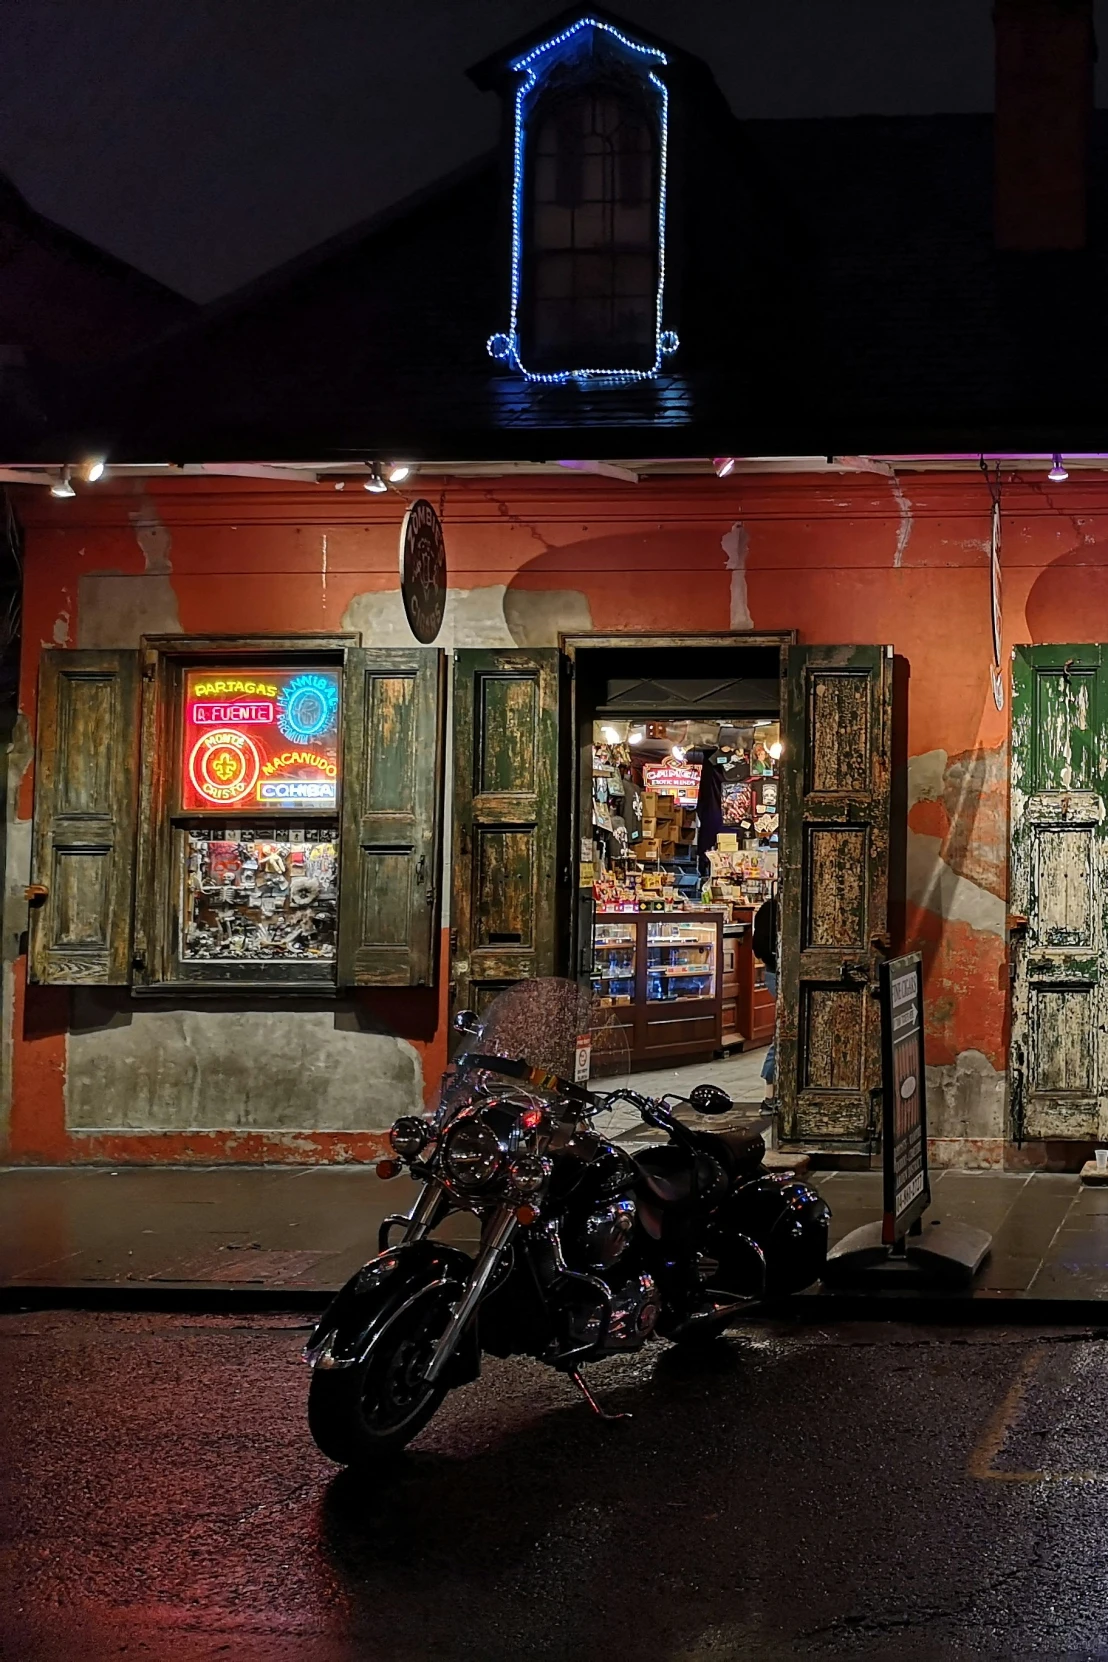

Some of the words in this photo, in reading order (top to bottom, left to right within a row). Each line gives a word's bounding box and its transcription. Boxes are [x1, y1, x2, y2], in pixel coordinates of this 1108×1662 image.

[195, 681, 277, 697] PARTAGAS
[212, 706, 267, 720] FUENTE
[204, 733, 245, 749] MONTE
[261, 752, 337, 777] MACANUDO
[646, 769, 701, 781] CAMEL
[202, 782, 246, 799] CRISTO
[262, 784, 334, 798] COHIBA
